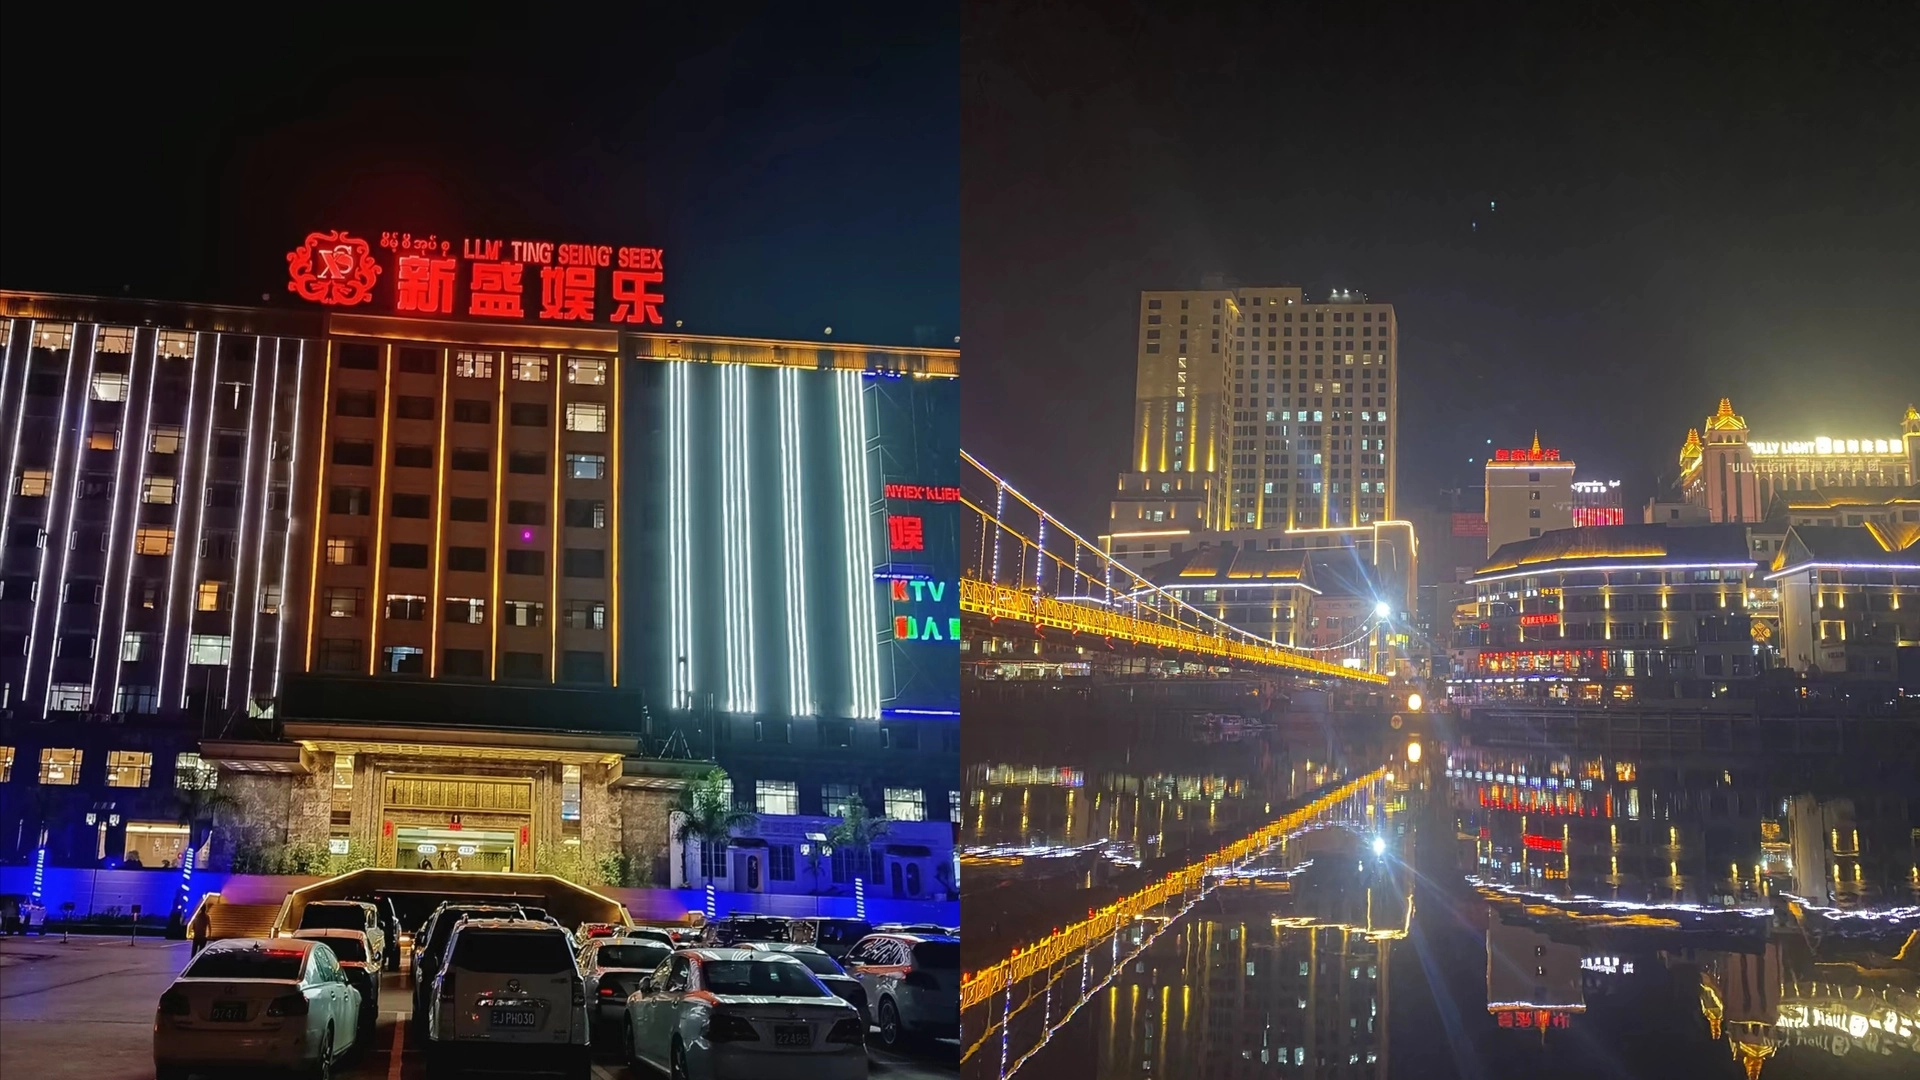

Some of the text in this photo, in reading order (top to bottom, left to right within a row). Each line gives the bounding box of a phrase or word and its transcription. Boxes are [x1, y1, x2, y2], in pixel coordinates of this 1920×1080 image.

[511, 241, 554, 263] TING'
[558, 244, 613, 267] SEING'
[618, 247, 663, 269] SEEX
[397, 255, 664, 324] 新盛娱乐
[889, 515, 923, 550] 娱
[892, 580, 945, 602] KTV
